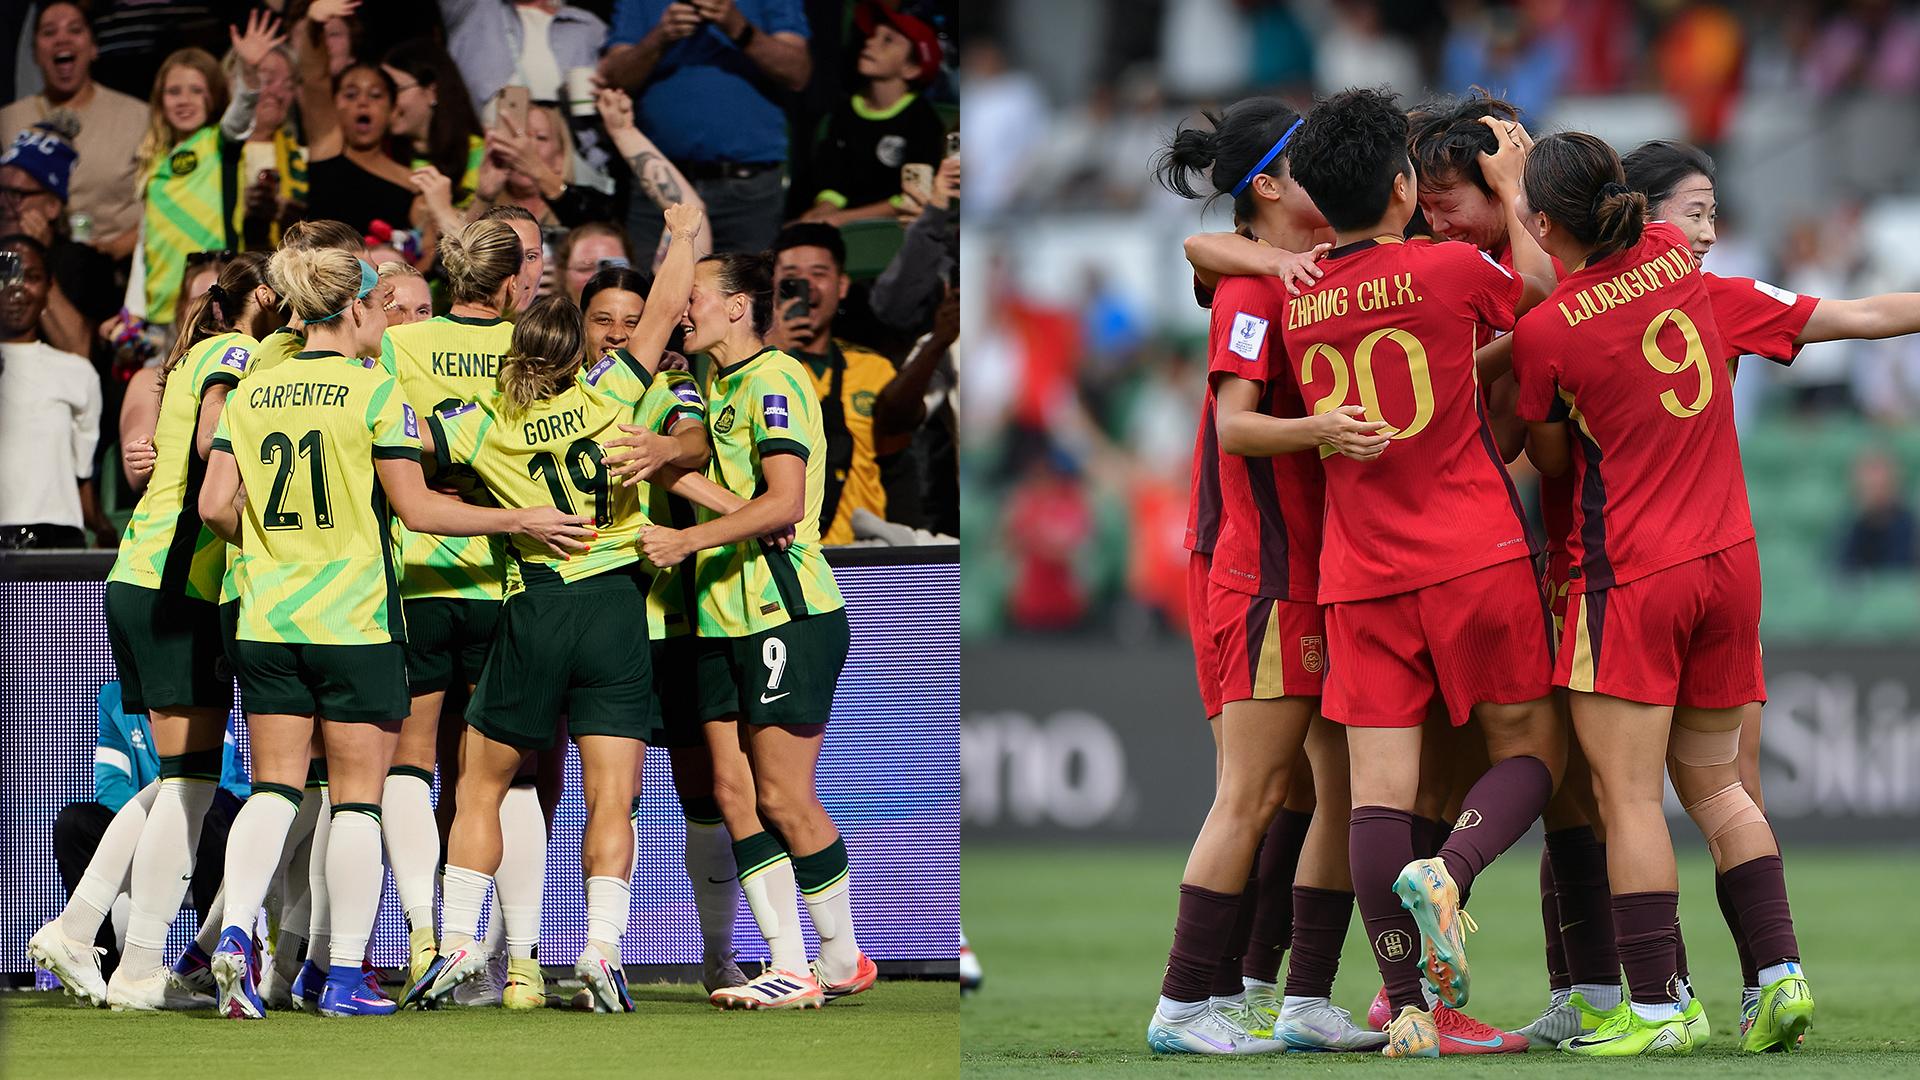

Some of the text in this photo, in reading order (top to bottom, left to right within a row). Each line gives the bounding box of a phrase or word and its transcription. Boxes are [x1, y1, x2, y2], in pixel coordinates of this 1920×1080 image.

[1287, 272, 1424, 331] ZHANG CH.X.
[250, 382, 350, 410] CARPENTER
[1301, 327, 1436, 460] 20
[1641, 308, 1714, 419] 9
[523, 405, 588, 446] GORRY
[260, 429, 335, 531] 21
[527, 437, 615, 530] 19
[761, 636, 788, 690] 9
[960, 708, 1128, 829] no
